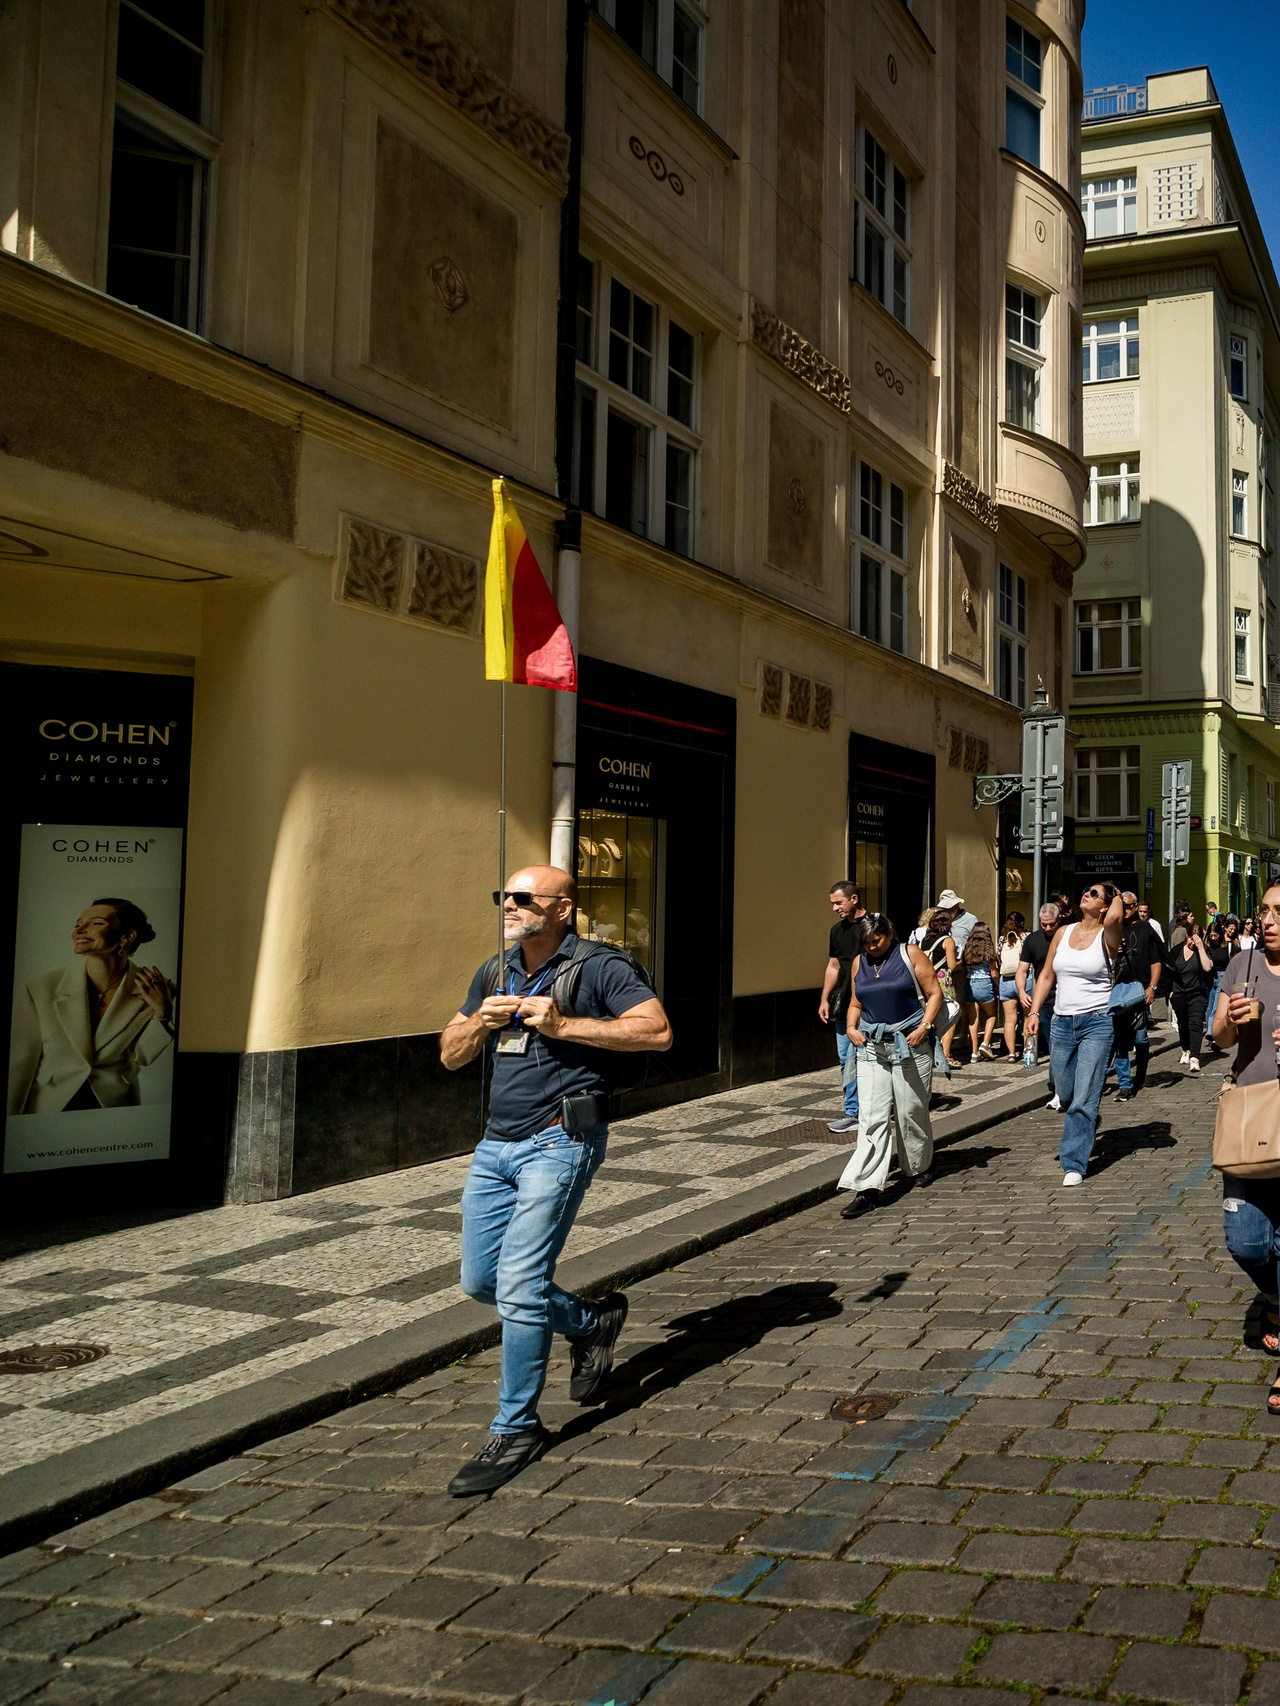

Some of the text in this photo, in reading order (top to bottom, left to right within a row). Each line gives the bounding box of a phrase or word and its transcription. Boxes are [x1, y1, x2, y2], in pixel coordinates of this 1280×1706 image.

[39, 719, 170, 746] COHEN
[50, 752, 161, 766] DIAMONDS
[599, 757, 650, 779] COHEN
[40, 774, 169, 785] JEWELLERY
[609, 782, 640, 792] GARNET
[52, 839, 149, 853] COHEN
[67, 855, 134, 864] DIAMONDS
[27, 1141, 154, 1159] www.cohencentre.com
